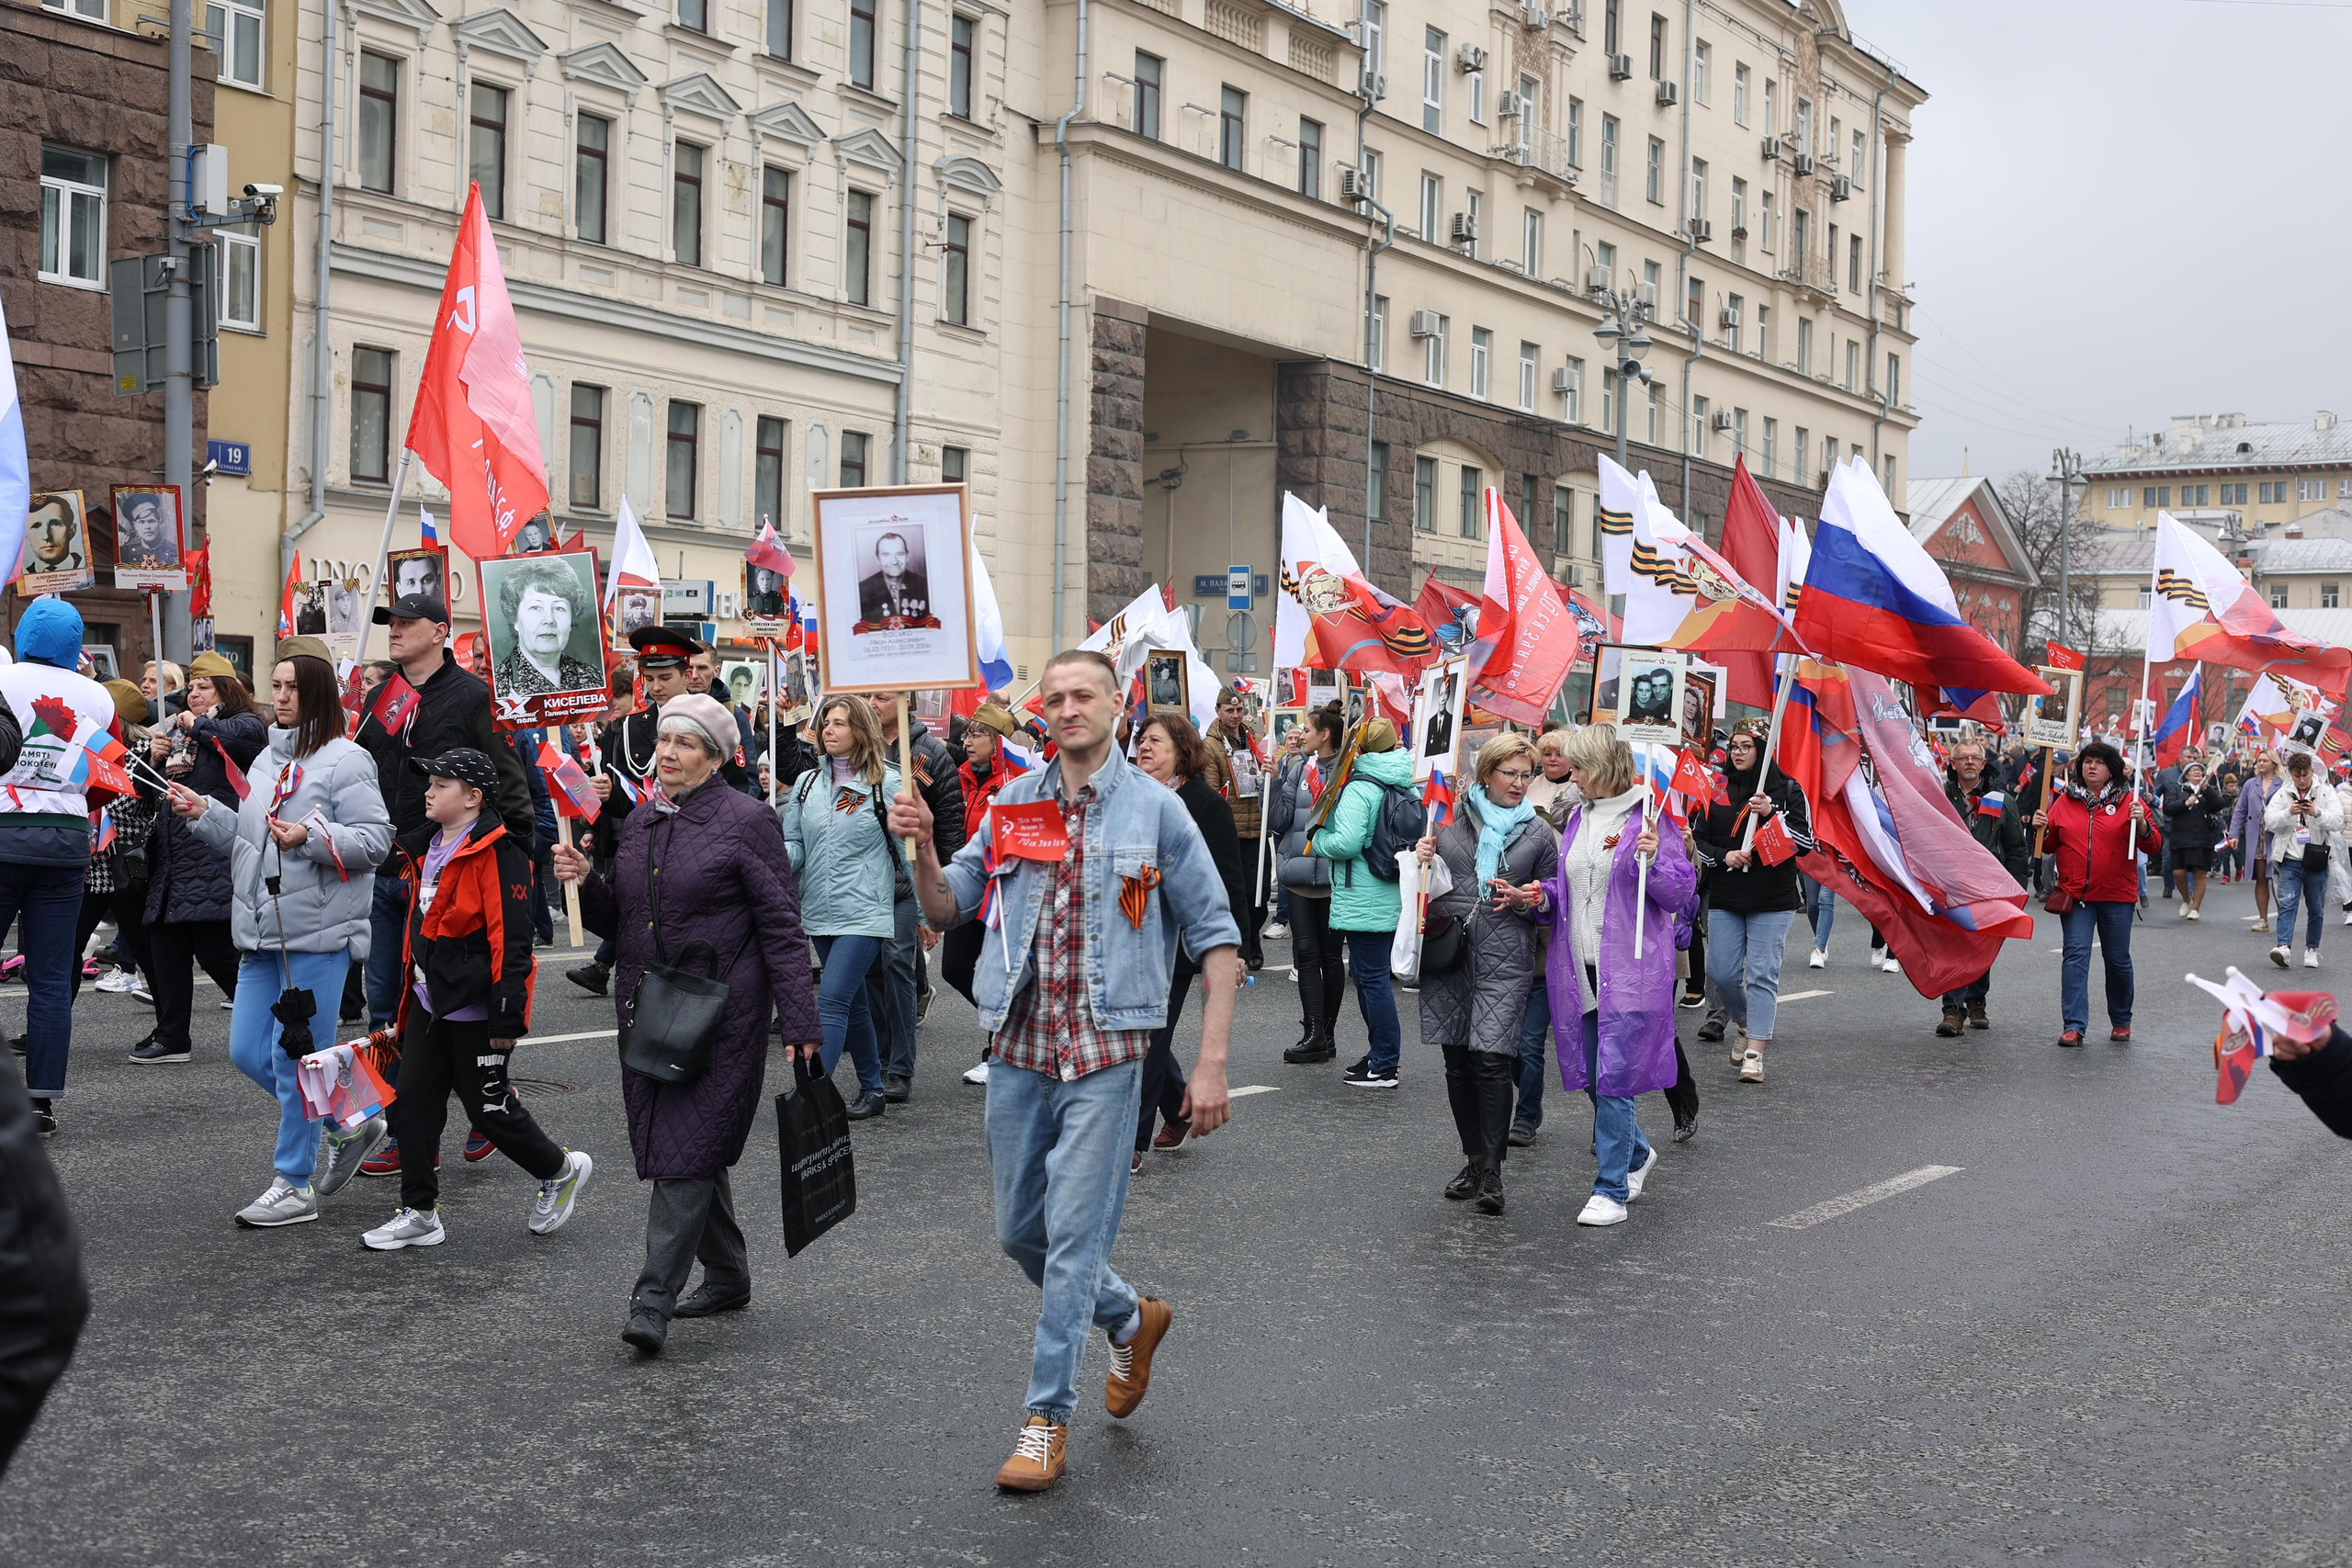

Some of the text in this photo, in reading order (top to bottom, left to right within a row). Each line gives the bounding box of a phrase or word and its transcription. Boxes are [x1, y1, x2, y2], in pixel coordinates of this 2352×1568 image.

[227, 447, 242, 464] 19
[883, 630, 912, 638] Васько
[544, 694, 606, 708] КИСЕЛЕВА
[570, 706, 609, 715] Семеновна
